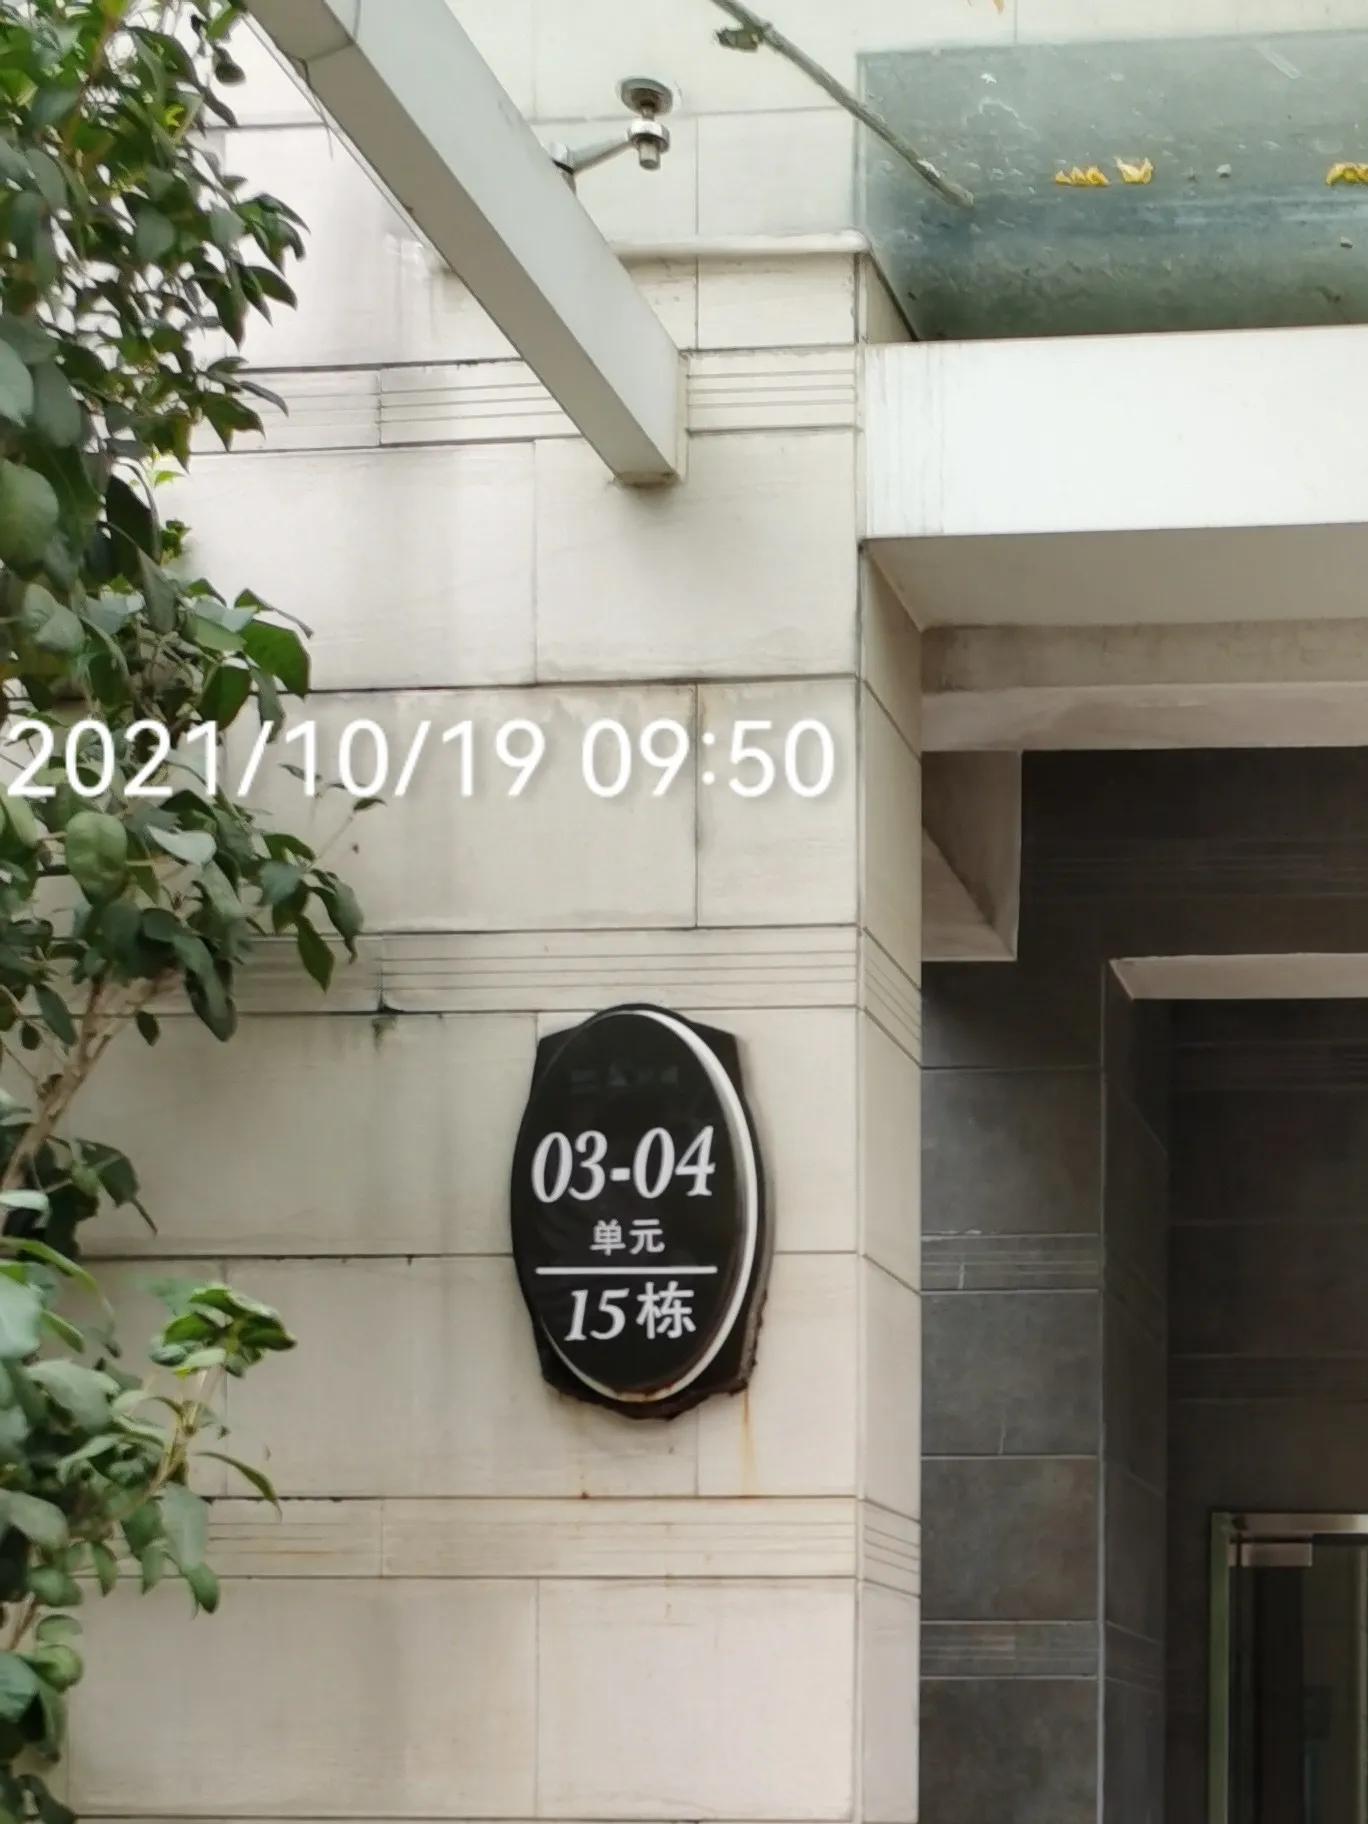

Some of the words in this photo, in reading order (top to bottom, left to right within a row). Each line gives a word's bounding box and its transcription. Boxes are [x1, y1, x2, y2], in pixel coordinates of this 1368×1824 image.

[531, 1125, 717, 1203] 03-04
[589, 1218, 666, 1257] 单元
[563, 1280, 697, 1342] 15栋
